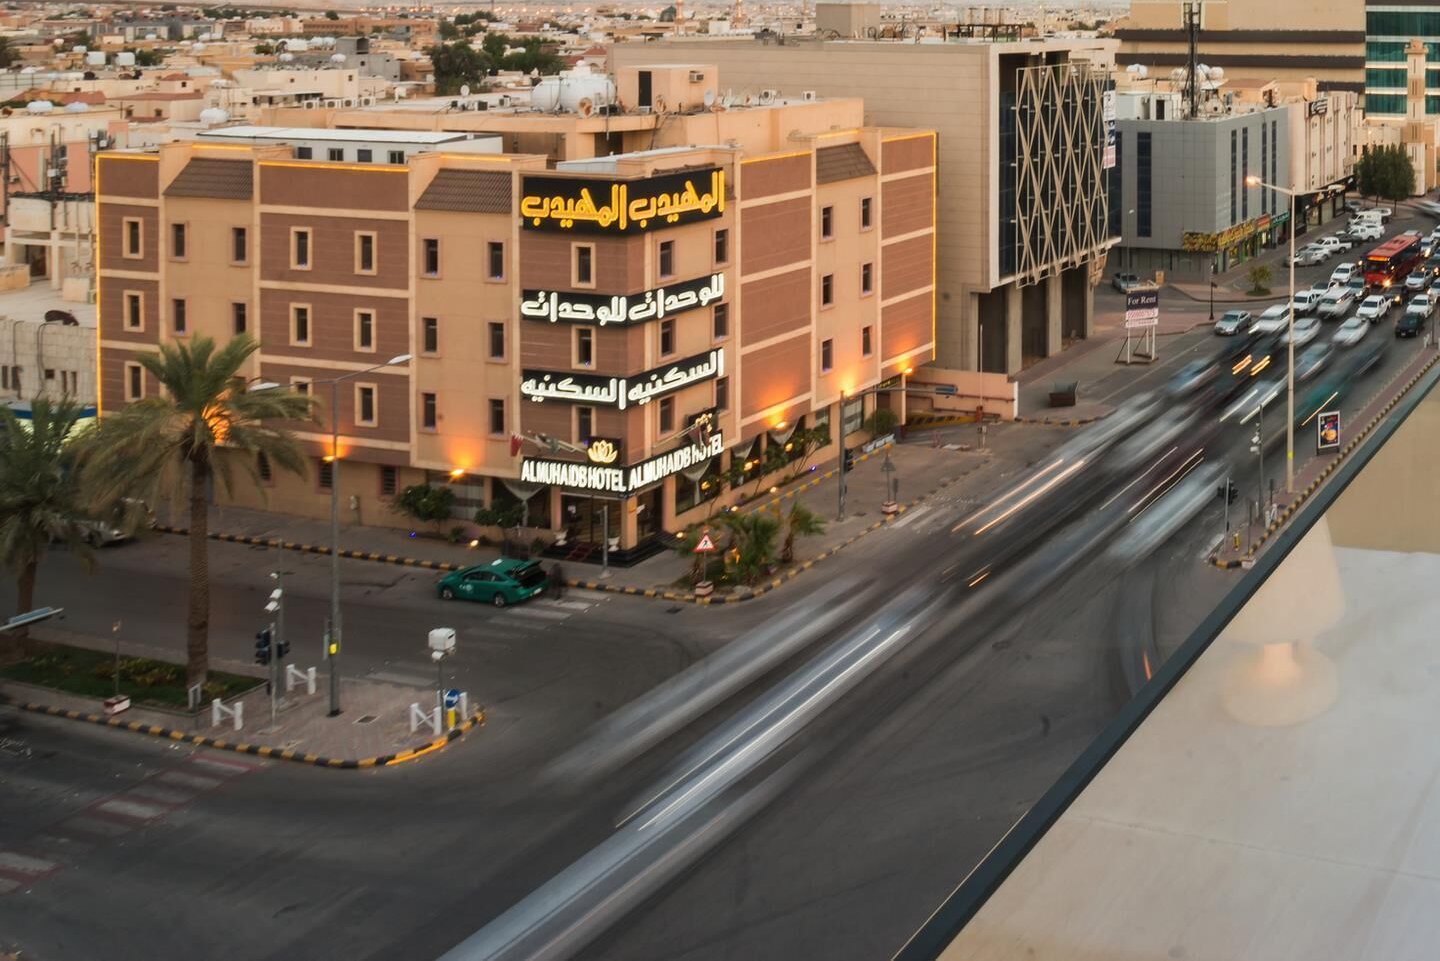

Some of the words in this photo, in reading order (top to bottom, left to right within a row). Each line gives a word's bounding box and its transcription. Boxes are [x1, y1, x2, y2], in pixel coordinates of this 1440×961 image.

[521, 183, 628, 230] المهيدب
[628, 170, 725, 228] المهيدب
[520, 290, 628, 326] للوحدات
[628, 273, 725, 320] للوحدات
[1127, 297, 1140, 306] For
[1140, 295, 1157, 304] Rent
[520, 373, 628, 410] السكنيه
[627, 348, 725, 406] السكنيه
[587, 466, 627, 493] HOTEL
